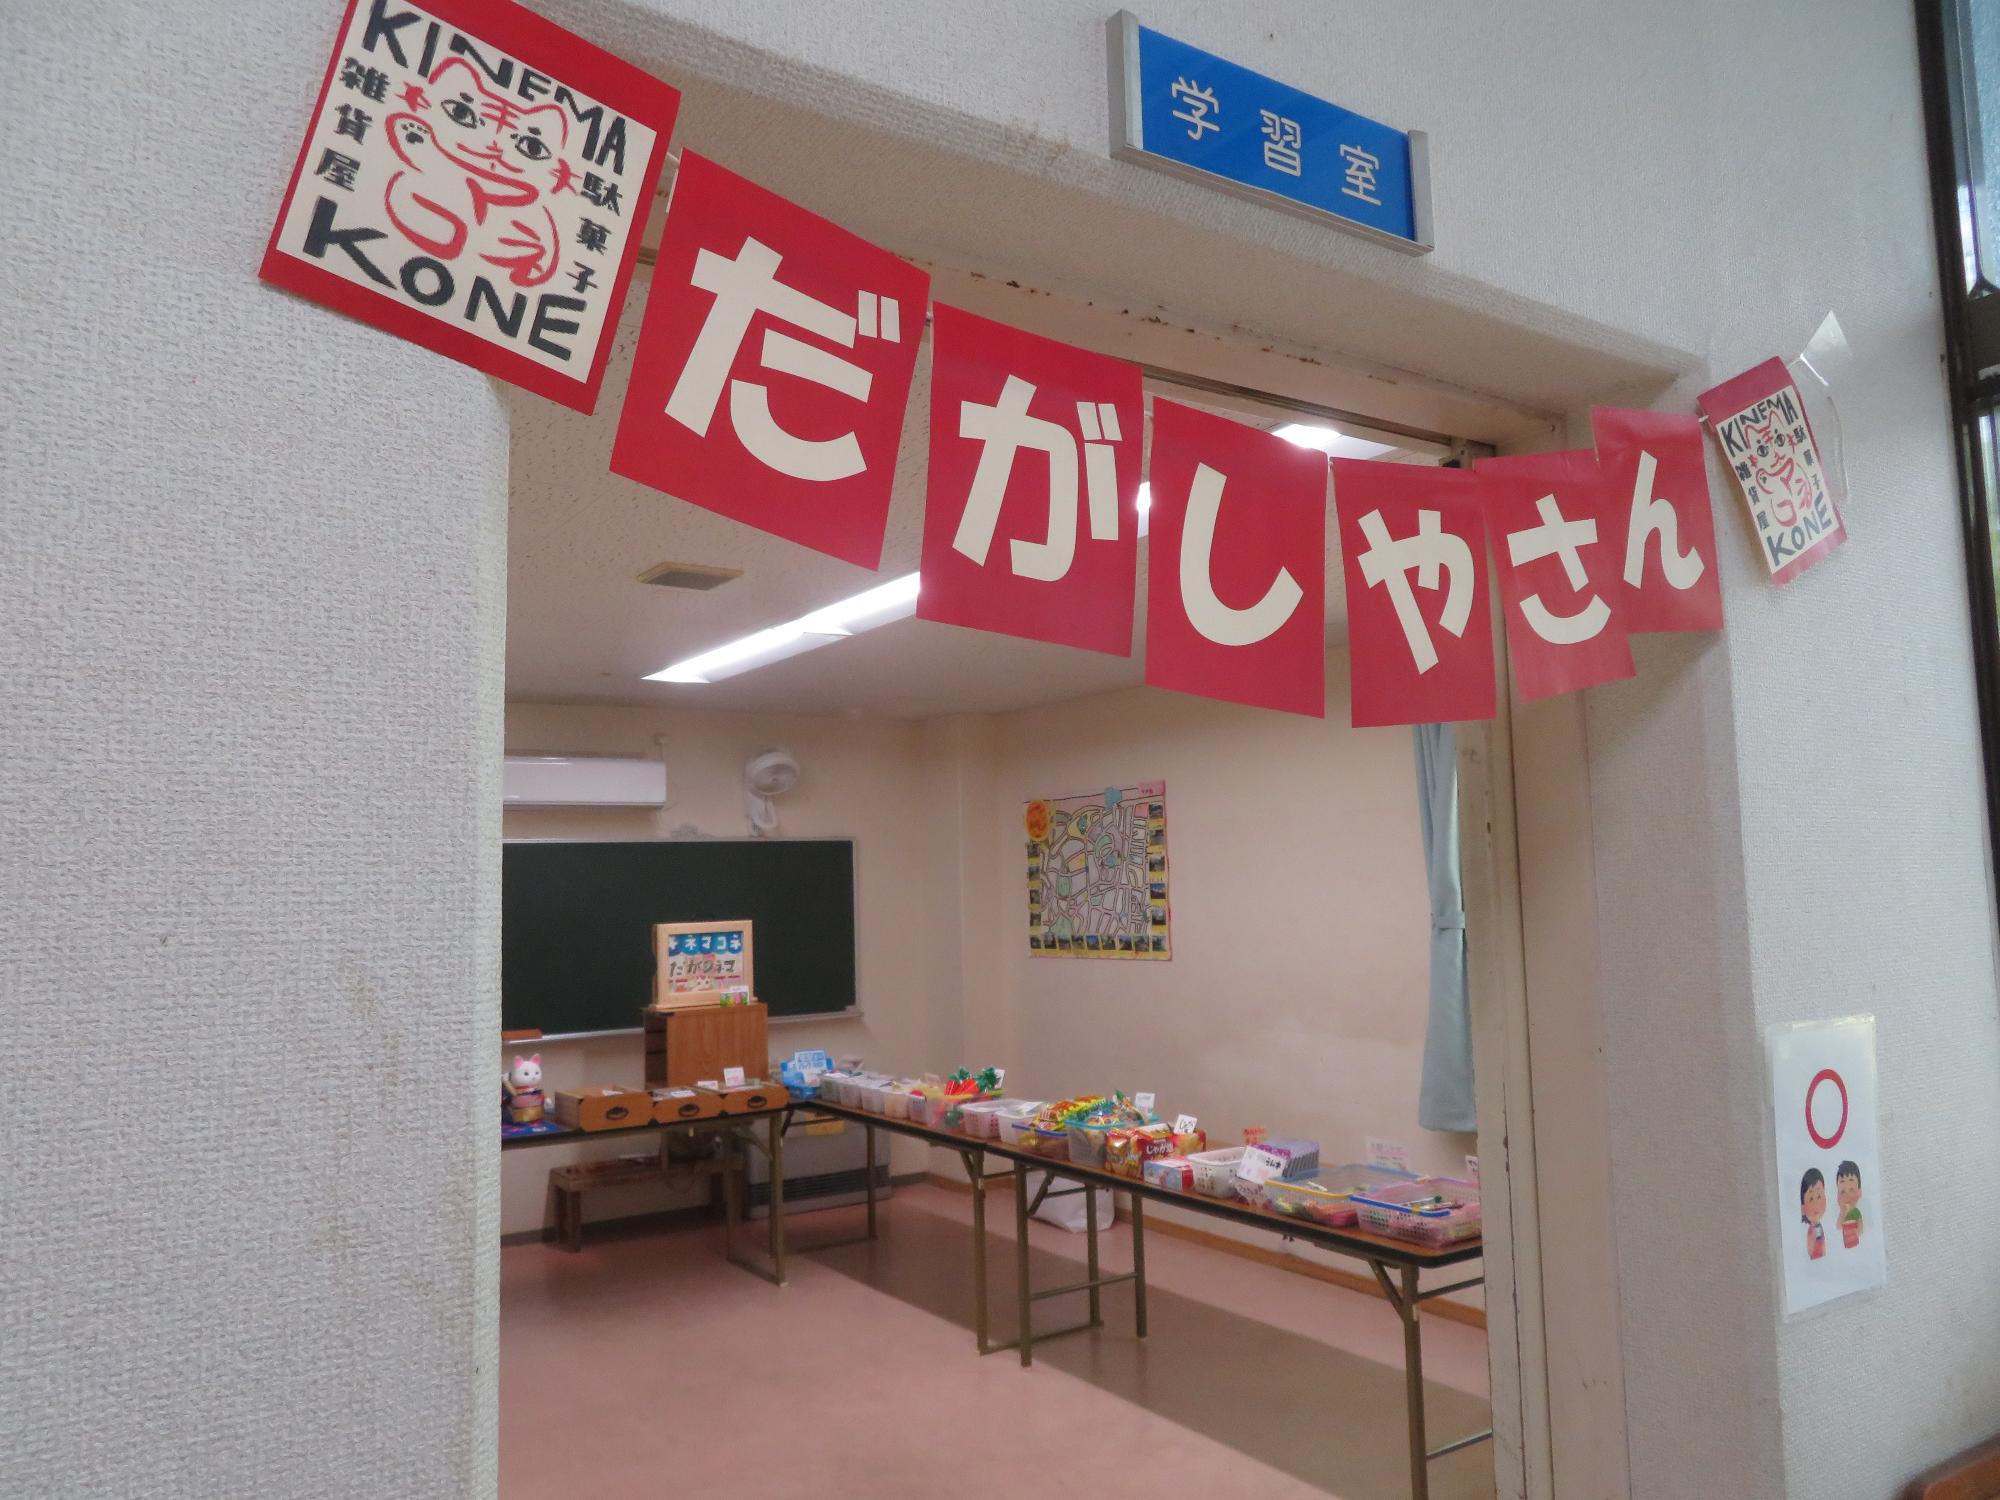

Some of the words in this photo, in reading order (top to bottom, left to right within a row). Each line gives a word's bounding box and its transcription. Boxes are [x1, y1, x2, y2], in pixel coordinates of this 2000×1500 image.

[313, 56, 390, 192] 雑貨屋
[362, 0, 627, 176] KINEMA
[1171, 75, 1382, 206] 学習室
[302, 196, 587, 361] KONE
[565, 171, 623, 294] 駄菓子
[1720, 390, 1799, 458] KINEMA
[1766, 490, 1833, 567] KONE
